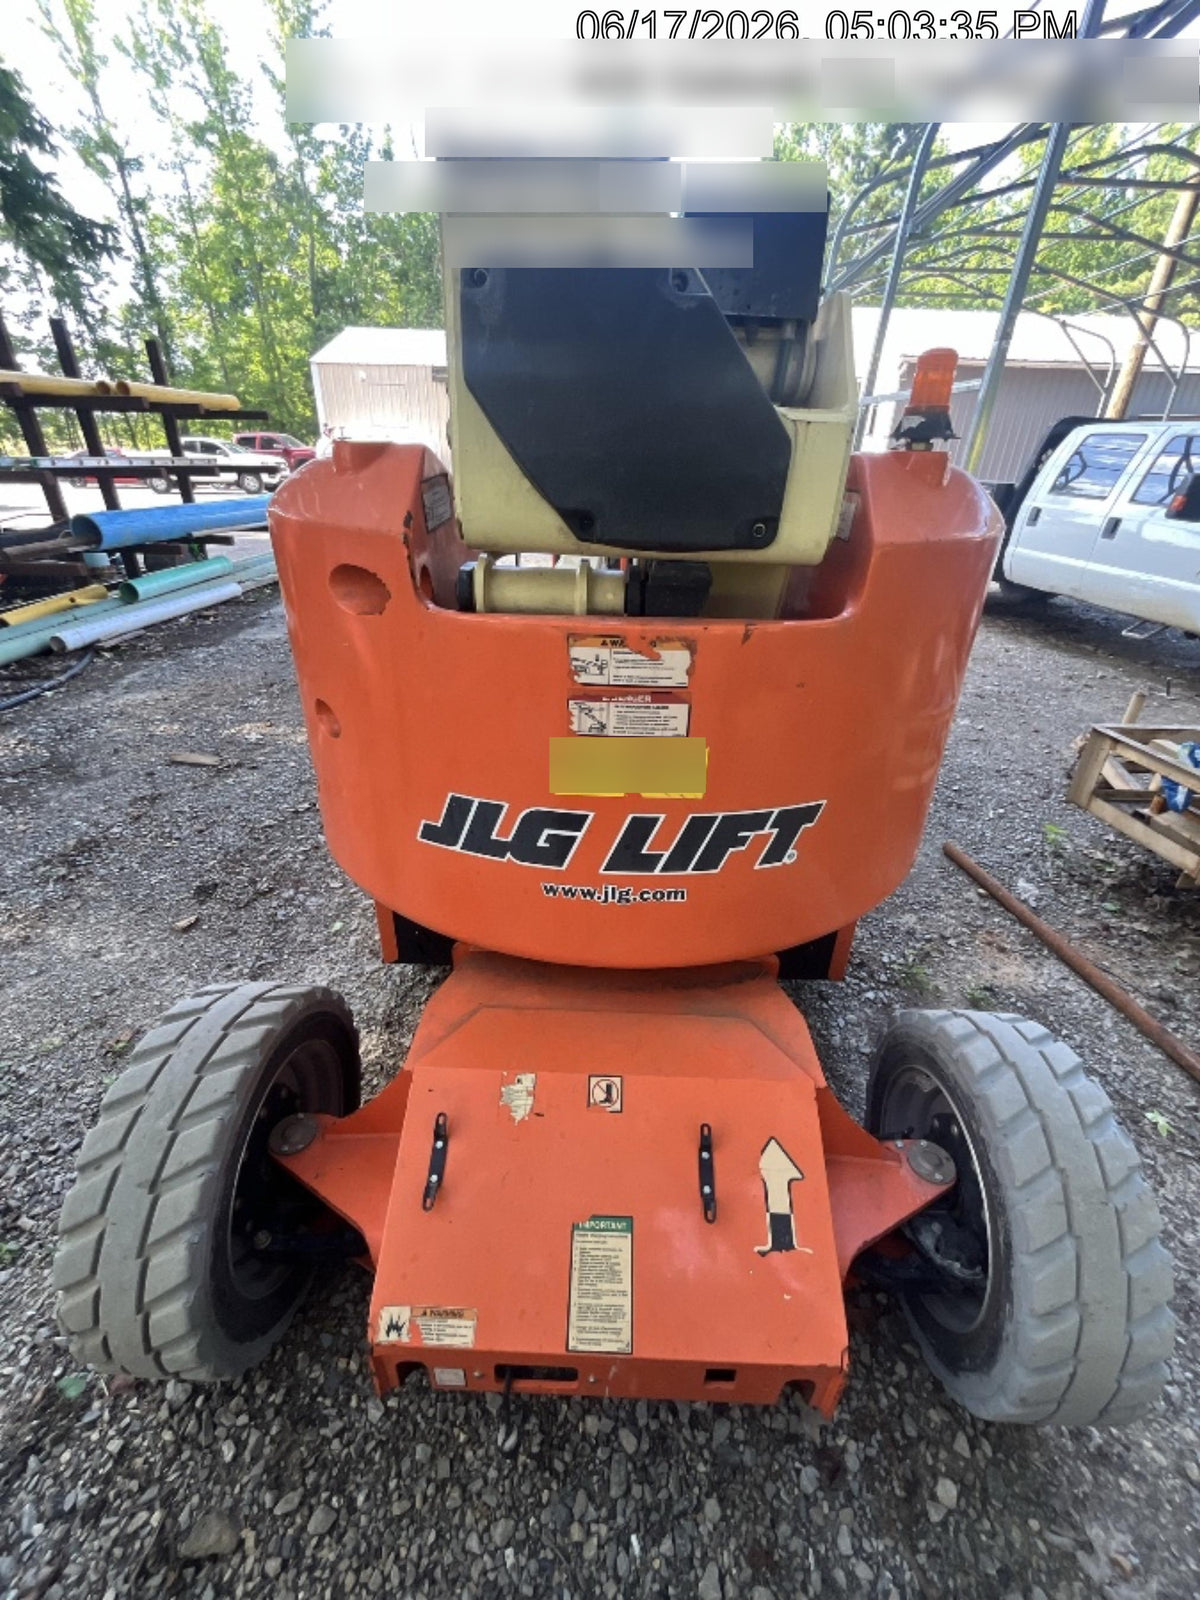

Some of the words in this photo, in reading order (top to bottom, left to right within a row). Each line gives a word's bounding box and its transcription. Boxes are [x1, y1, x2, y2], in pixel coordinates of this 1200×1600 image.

[417, 792, 595, 871] JLG
[599, 799, 828, 875] LIFT
[540, 882, 687, 905] www.jlg.com
